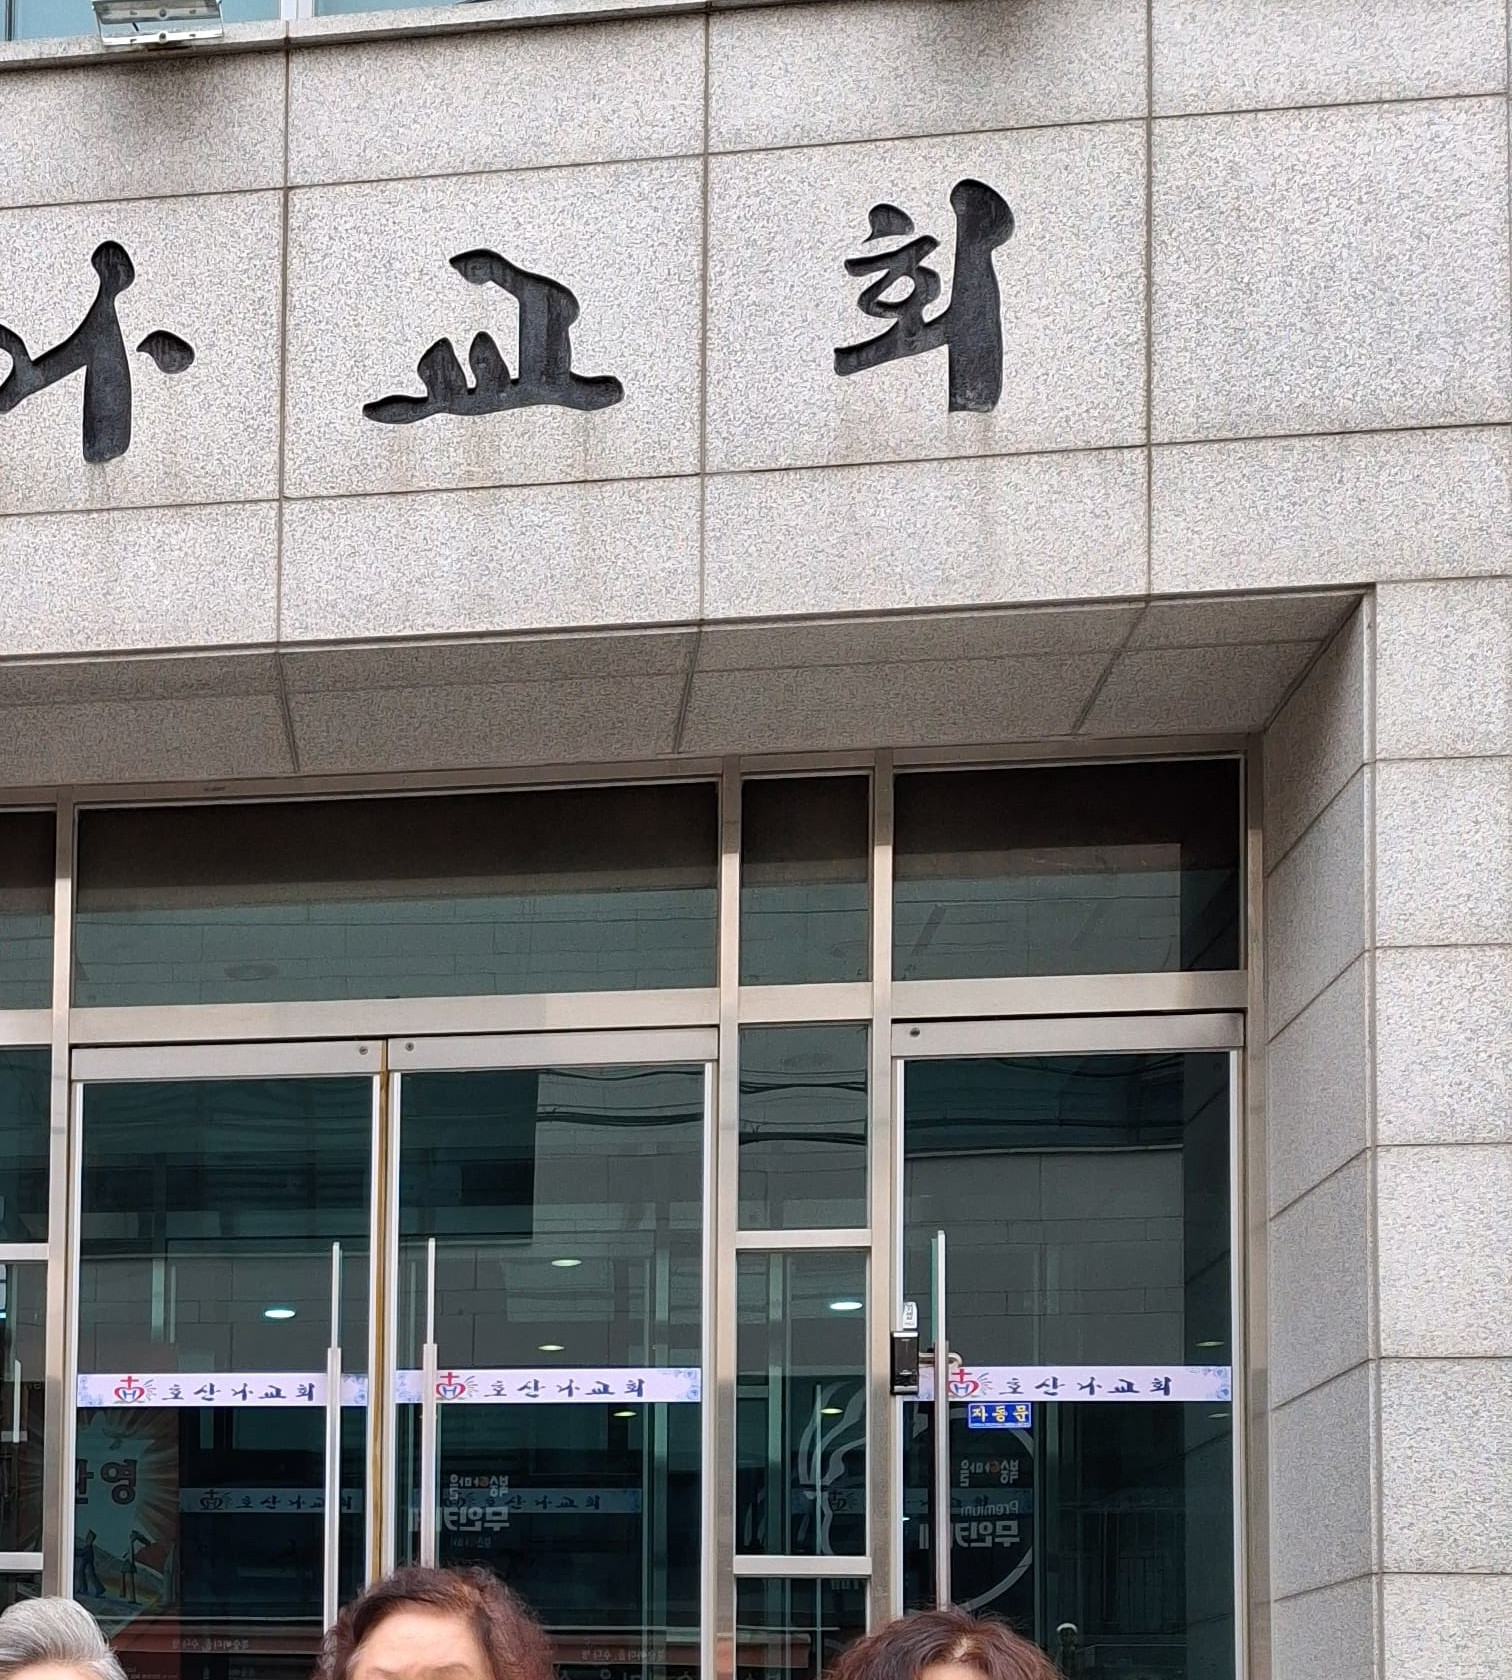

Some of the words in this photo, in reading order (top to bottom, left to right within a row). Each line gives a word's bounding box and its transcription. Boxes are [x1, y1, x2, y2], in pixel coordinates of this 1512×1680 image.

[162, 1383, 316, 1402] 호산나교회
[484, 1379, 645, 1398] 호산나교회
[999, 1376, 1172, 1396] 호산나교회
[971, 1405, 1031, 1423] 자동문
